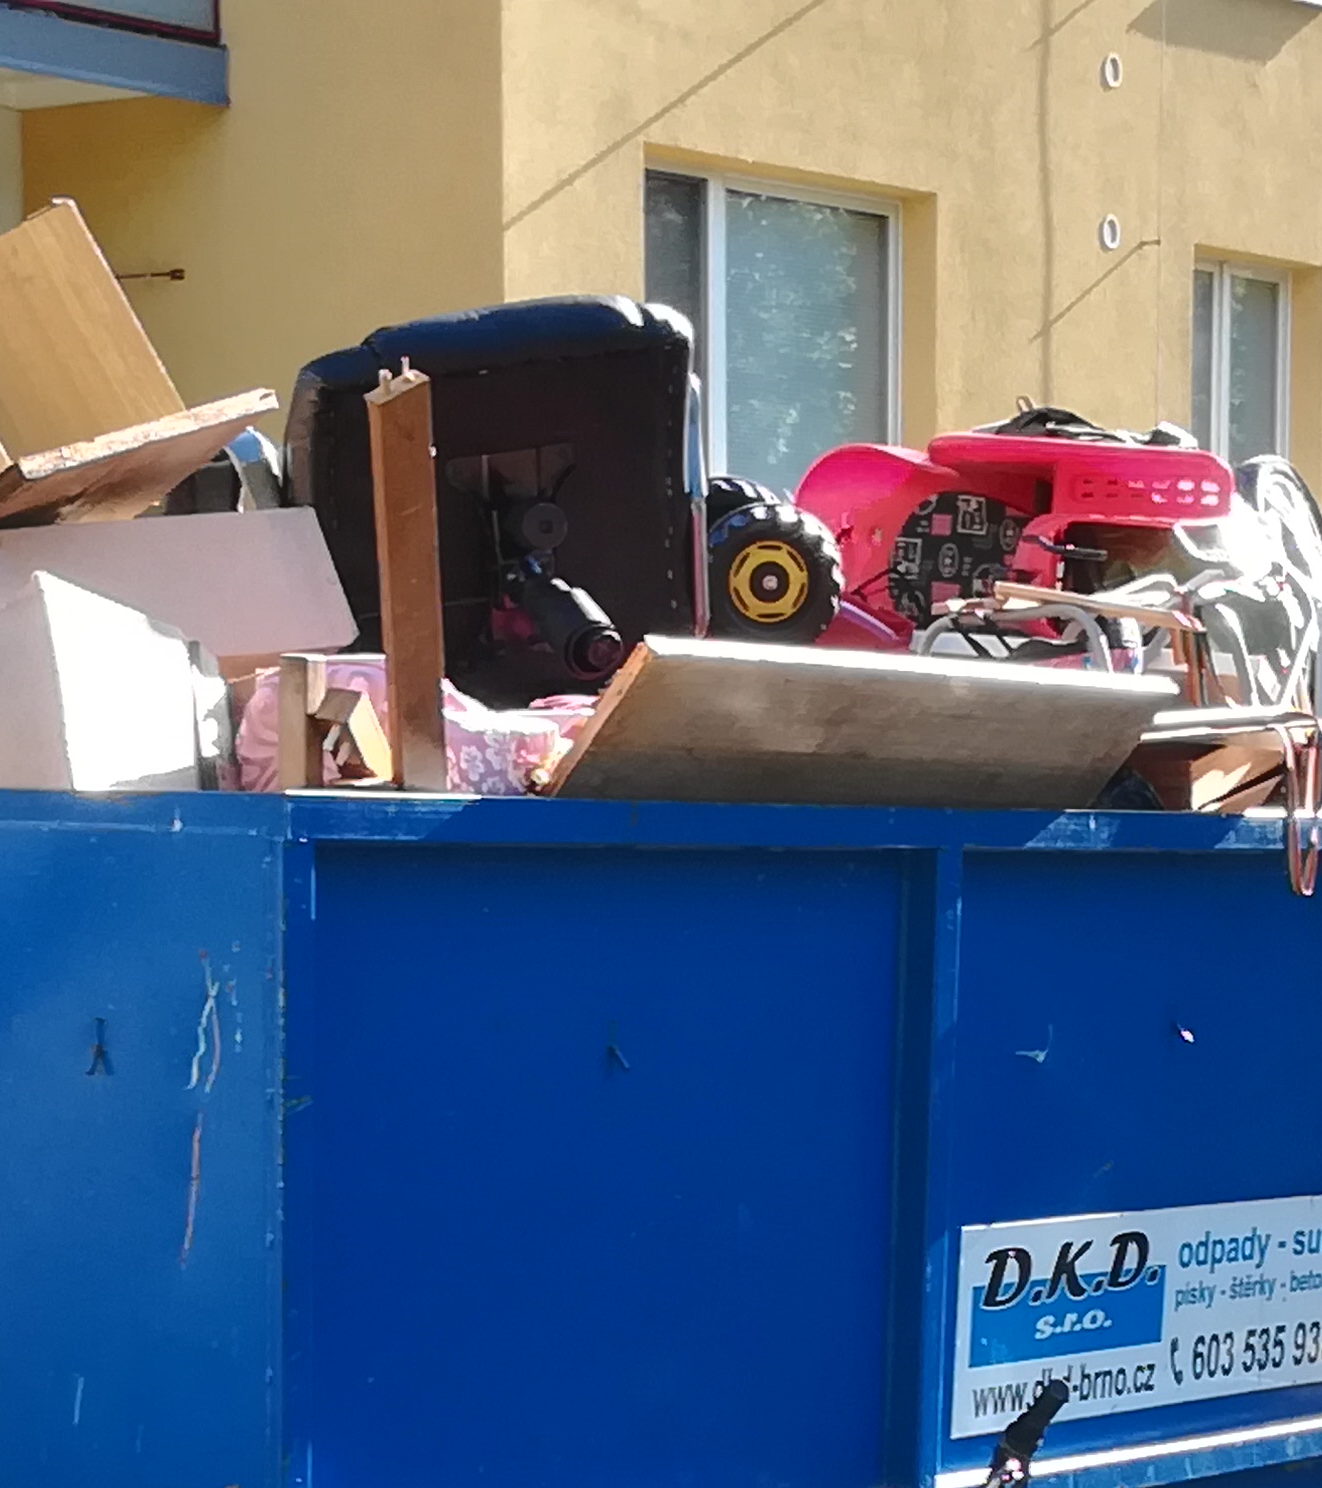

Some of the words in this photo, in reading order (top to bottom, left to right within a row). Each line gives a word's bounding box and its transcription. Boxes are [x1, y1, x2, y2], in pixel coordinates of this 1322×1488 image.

[981, 1231, 1161, 1310] D.K.D.
[1178, 1226, 1272, 1274] odpady
[1034, 1308, 1113, 1341] s.r.o.
[1192, 1331, 1235, 1380] 603
[1241, 1324, 1286, 1373] 535
